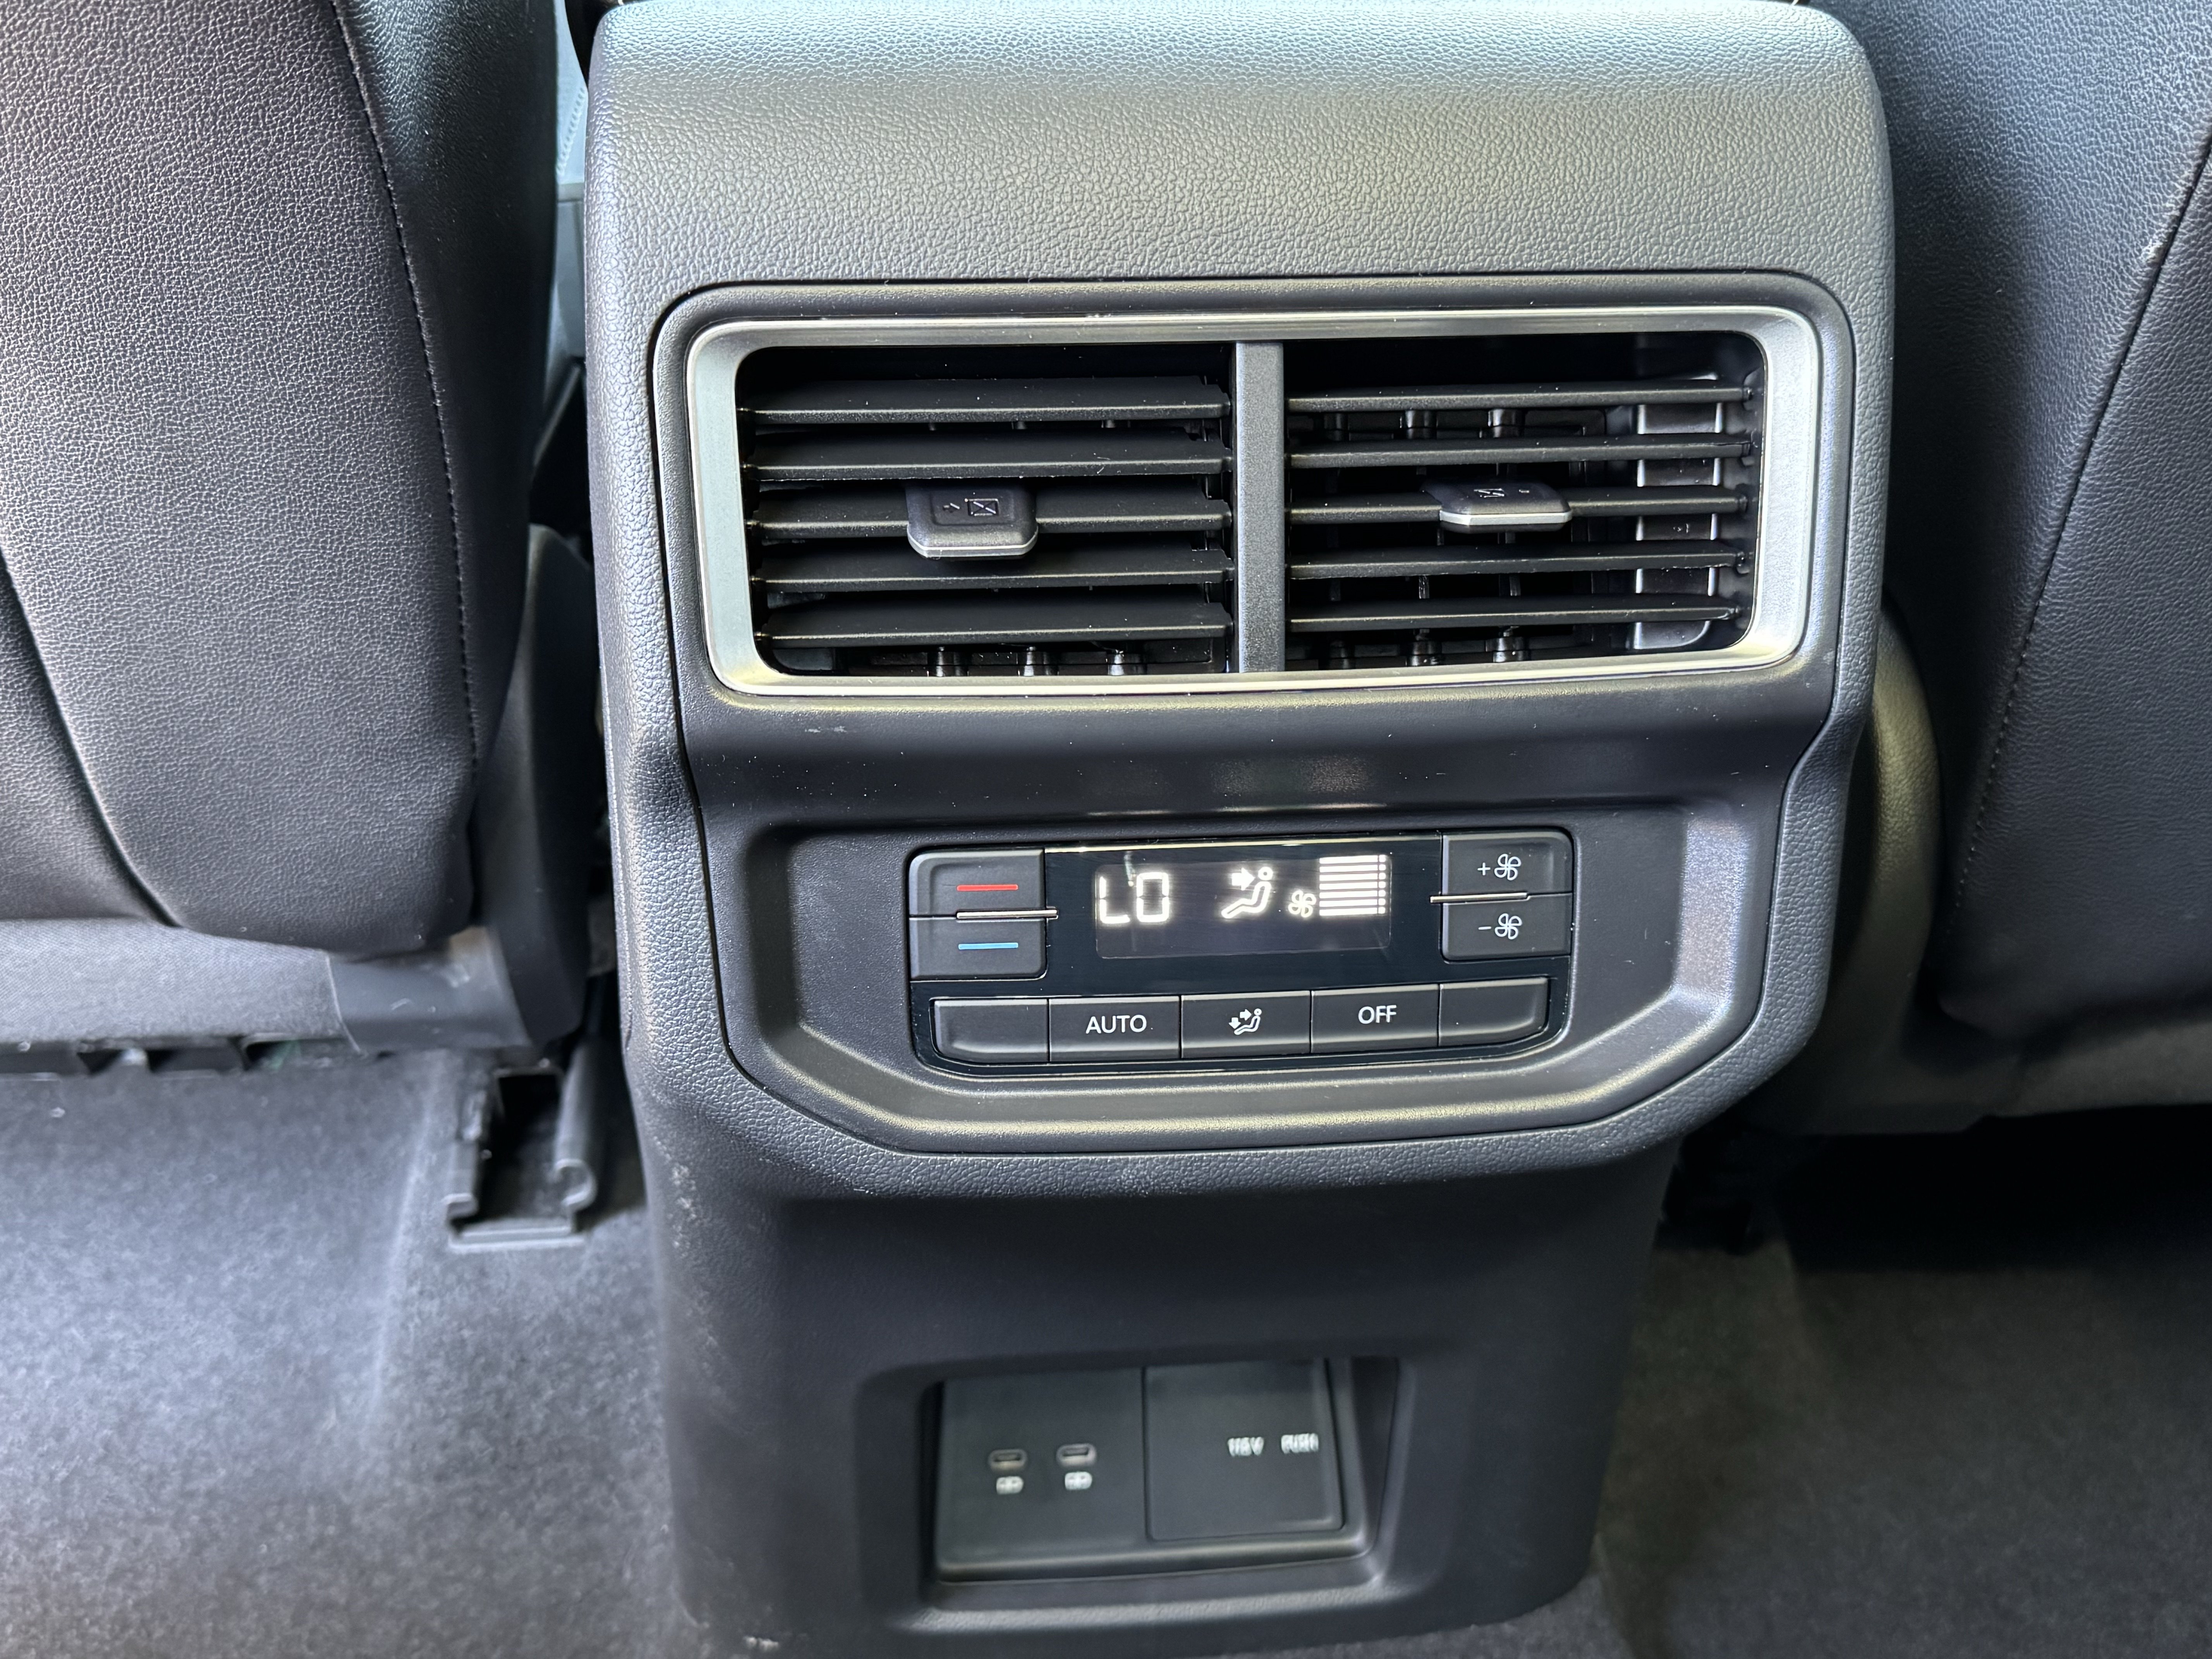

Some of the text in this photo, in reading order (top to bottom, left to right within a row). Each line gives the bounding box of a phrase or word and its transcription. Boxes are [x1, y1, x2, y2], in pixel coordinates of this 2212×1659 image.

[1099, 871, 1170, 924] LO
[1085, 1014, 1147, 1034] AUTO
[1358, 1005, 1397, 1025] OFF
